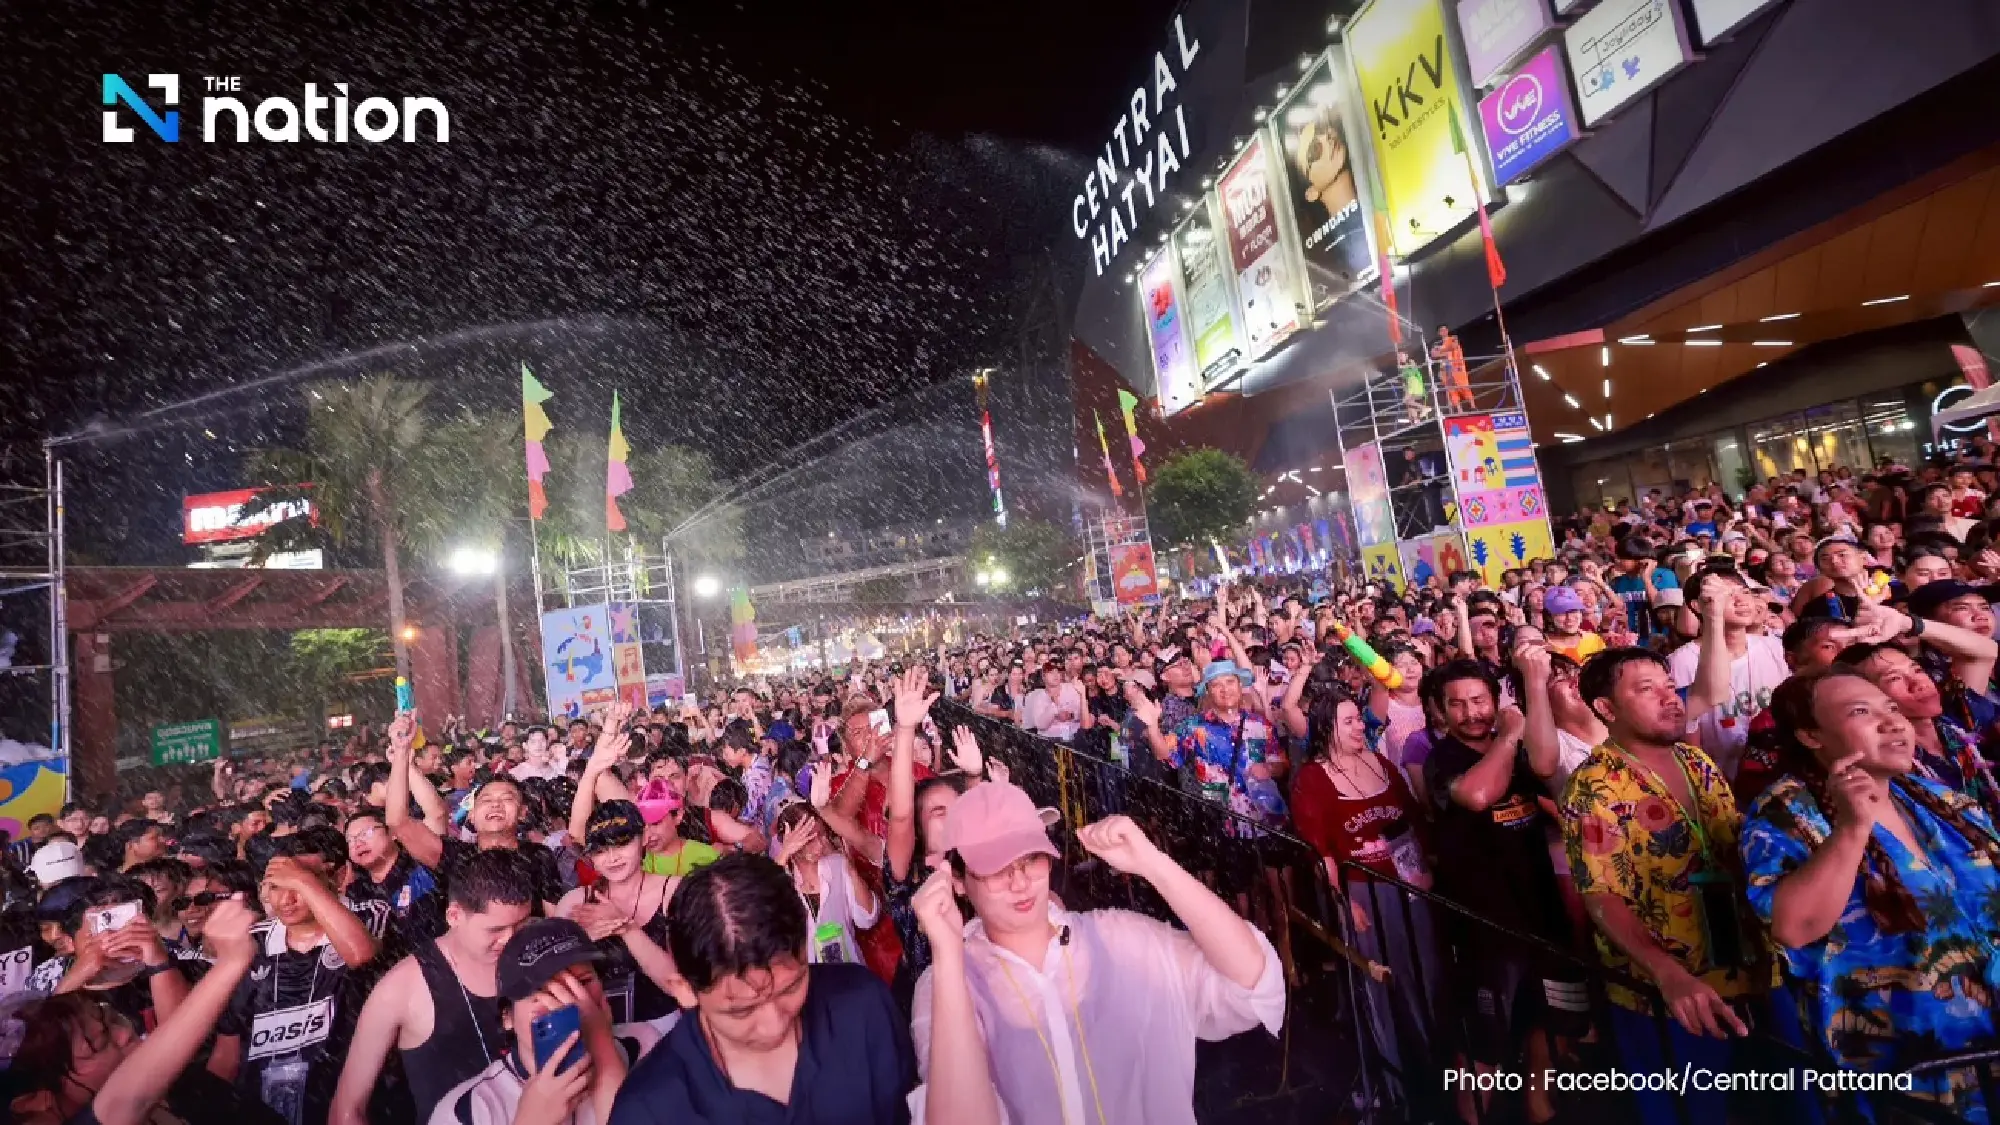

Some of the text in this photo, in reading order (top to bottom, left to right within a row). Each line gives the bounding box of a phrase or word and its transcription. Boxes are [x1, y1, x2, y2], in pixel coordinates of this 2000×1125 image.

[1374, 34, 1442, 139] KKV
[1073, 14, 1200, 239] CENTRAL
[1497, 140, 1520, 161] VIVE
[1519, 109, 1561, 146] FITNESS
[1092, 105, 1190, 276] HATYAI
[1306, 199, 1358, 249] OWNDAYS
[252, 1013, 326, 1048] oasis
